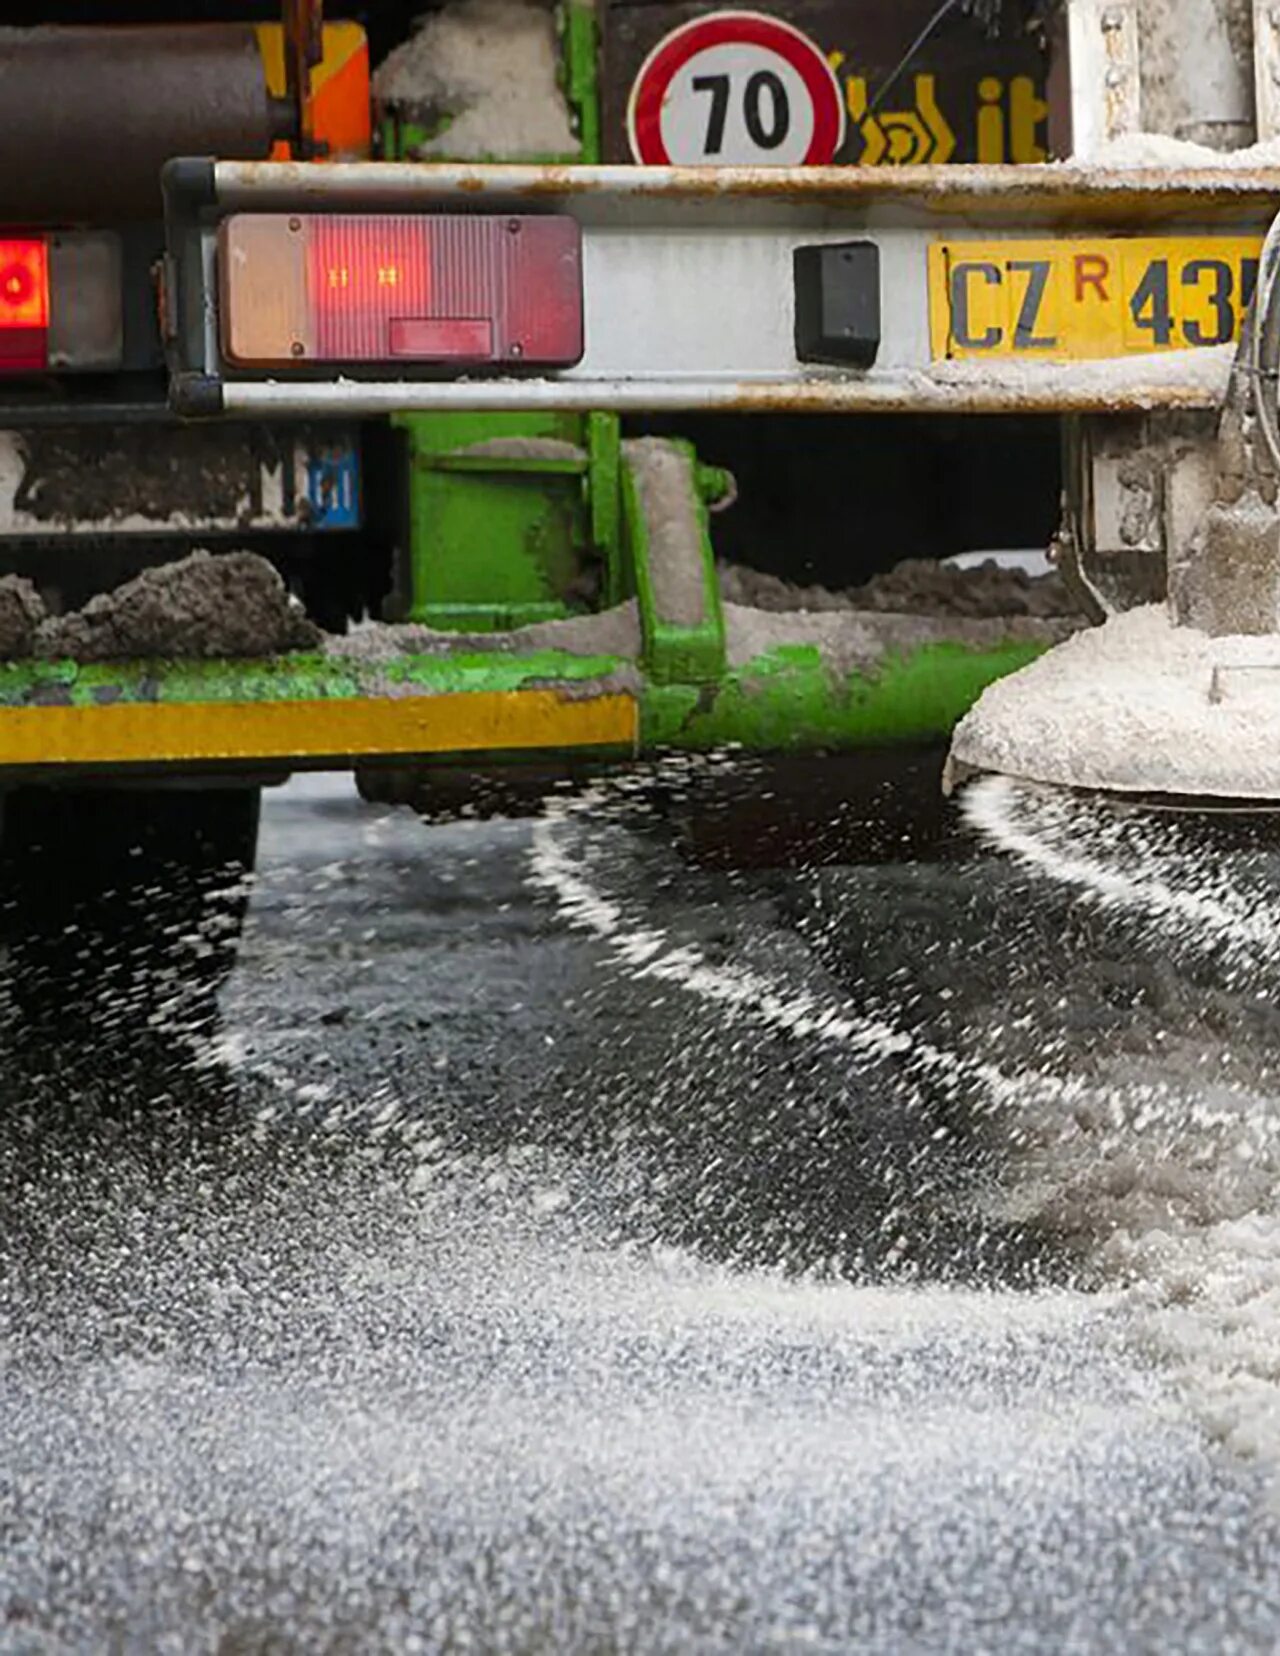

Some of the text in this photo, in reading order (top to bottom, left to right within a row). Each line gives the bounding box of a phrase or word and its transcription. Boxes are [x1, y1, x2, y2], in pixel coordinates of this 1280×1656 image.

[691, 69, 790, 156] 70
[949, 261, 1056, 349] CZ
[1074, 255, 1109, 302] R
